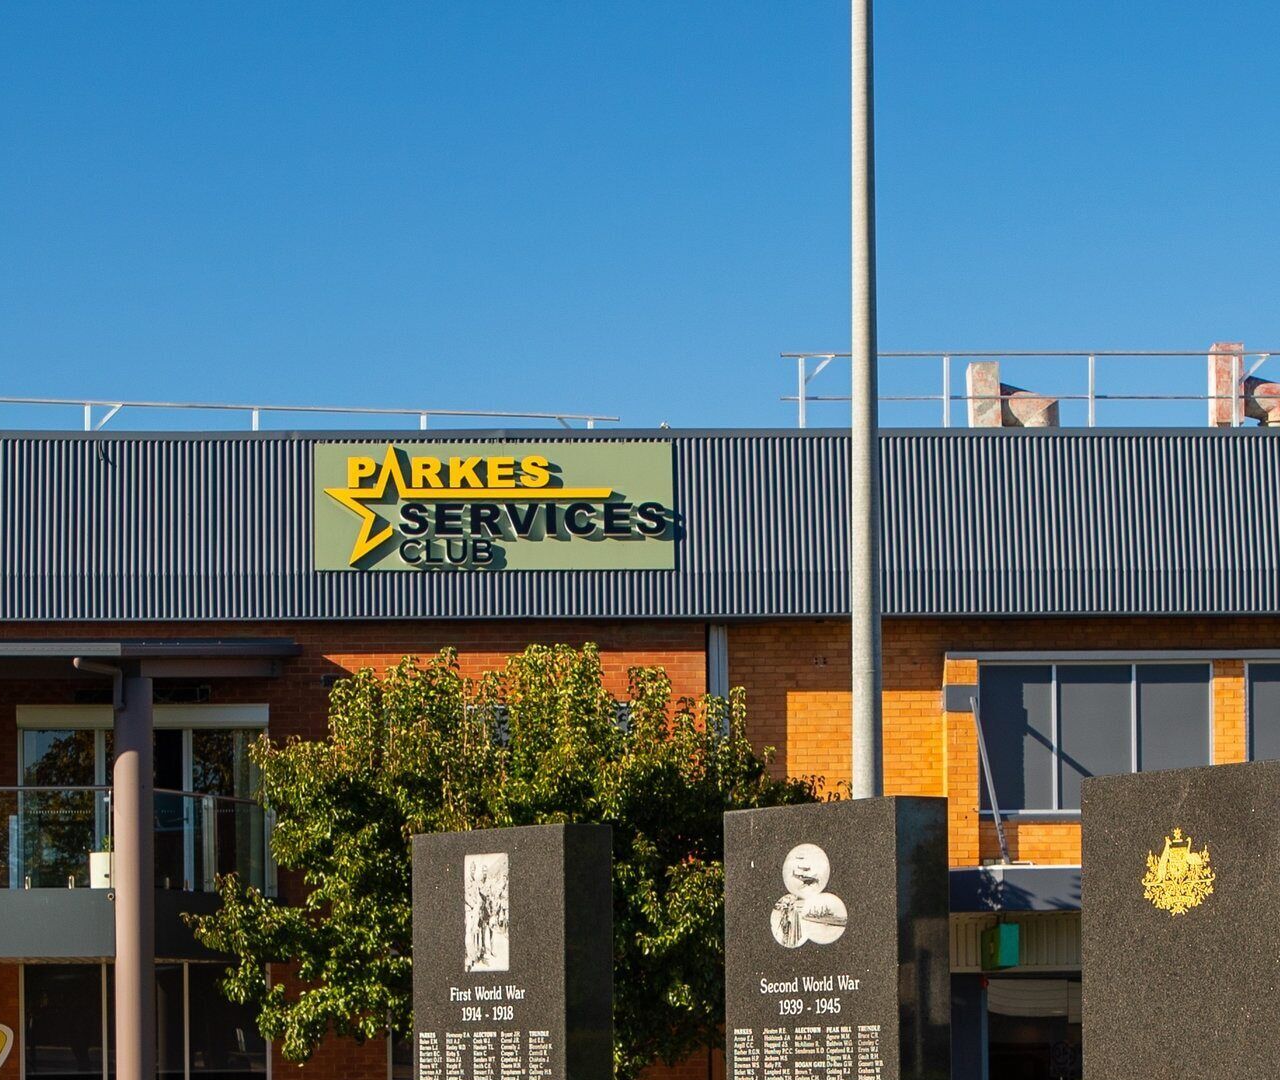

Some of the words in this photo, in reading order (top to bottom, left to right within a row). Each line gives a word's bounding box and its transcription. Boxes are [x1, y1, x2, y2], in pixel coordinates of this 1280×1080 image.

[347, 444, 550, 488] PARKES
[399, 503, 666, 537] SERVICES
[399, 538, 494, 565] CLUB
[450, 986, 472, 1001] First
[474, 985, 502, 1001] World
[505, 985, 526, 1000] War
[760, 977, 799, 994] Second
[802, 976, 834, 992] World
[837, 975, 860, 990] War
[461, 1006, 482, 1021] 1914
[492, 1006, 514, 1021] 1918
[778, 999, 804, 1015] 1939
[815, 998, 841, 1014] 1945
